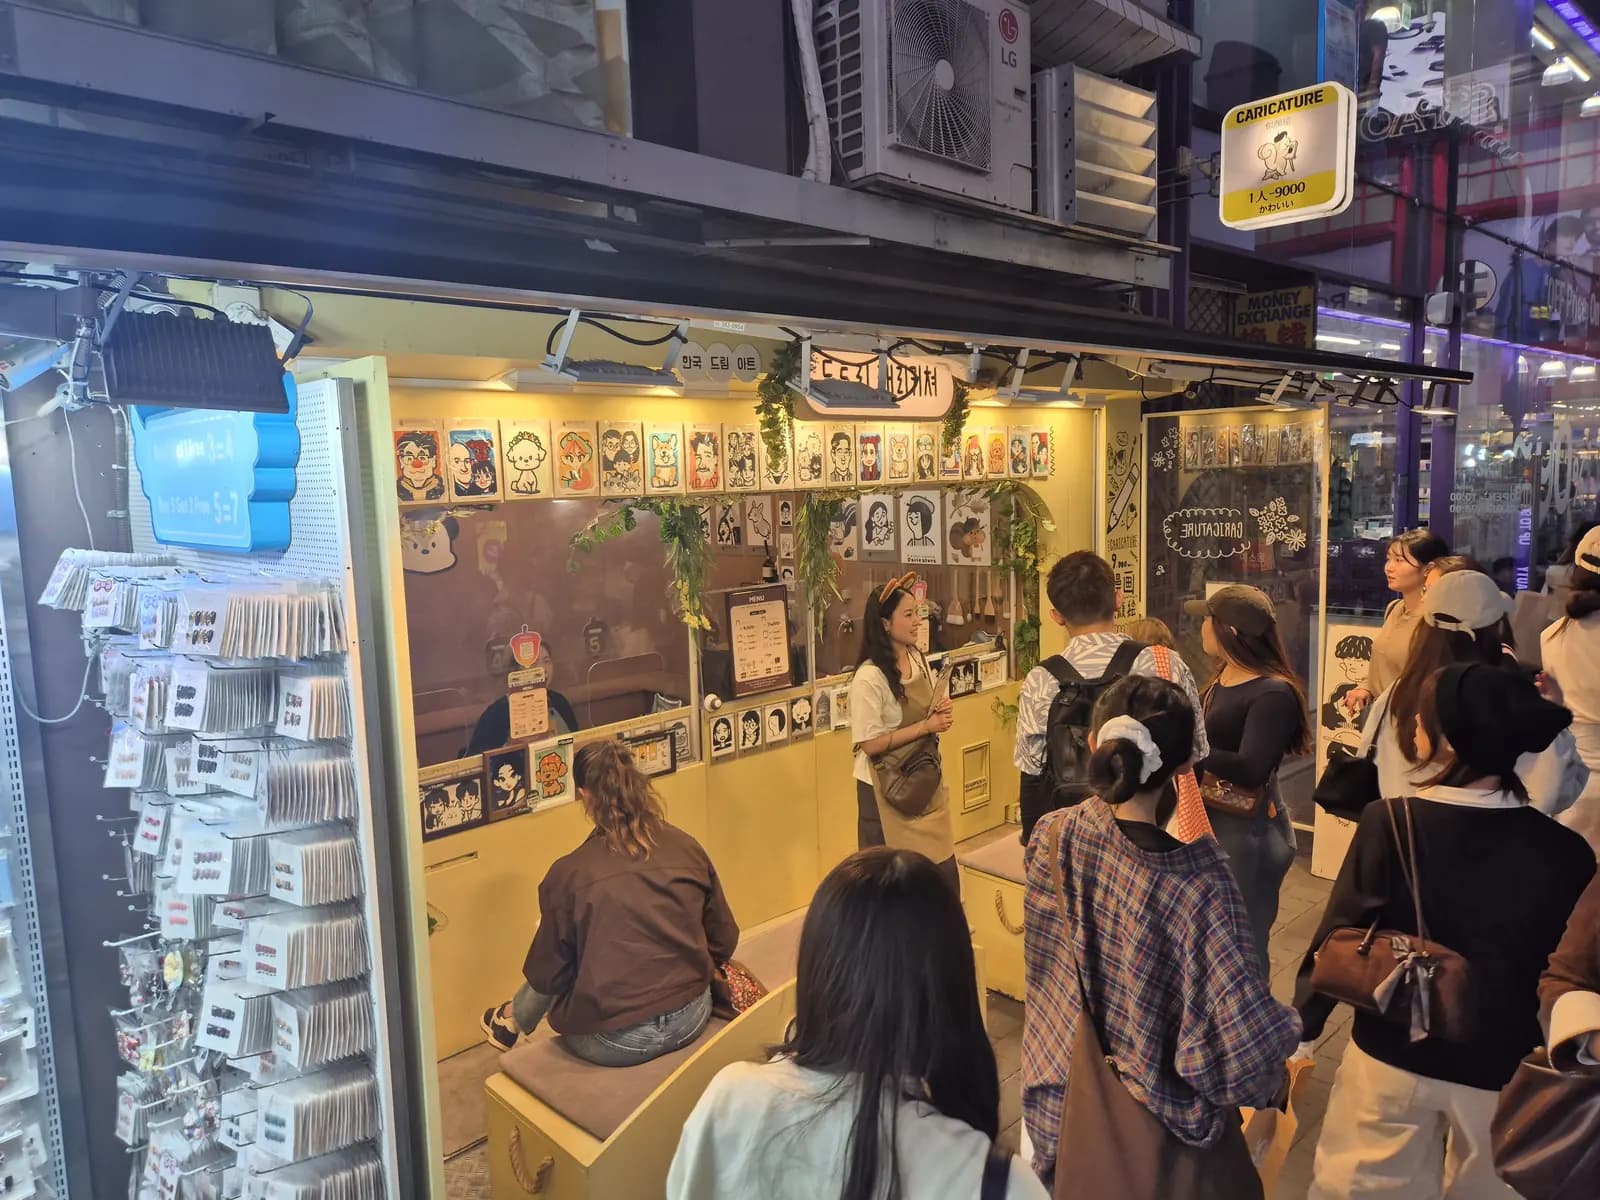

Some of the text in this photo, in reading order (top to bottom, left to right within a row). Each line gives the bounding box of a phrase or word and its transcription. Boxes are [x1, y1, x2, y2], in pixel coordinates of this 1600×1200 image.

[1001, 47, 1017, 68] LG
[1236, 89, 1324, 124] CARICATURE
[1259, 200, 1294, 214] かわいい
[1248, 292, 1300, 310] MONEY
[1238, 304, 1312, 325] EXCHANGE
[711, 356, 729, 370] 드림
[737, 357, 756, 370] 아트
[749, 594, 765, 603] MENU
